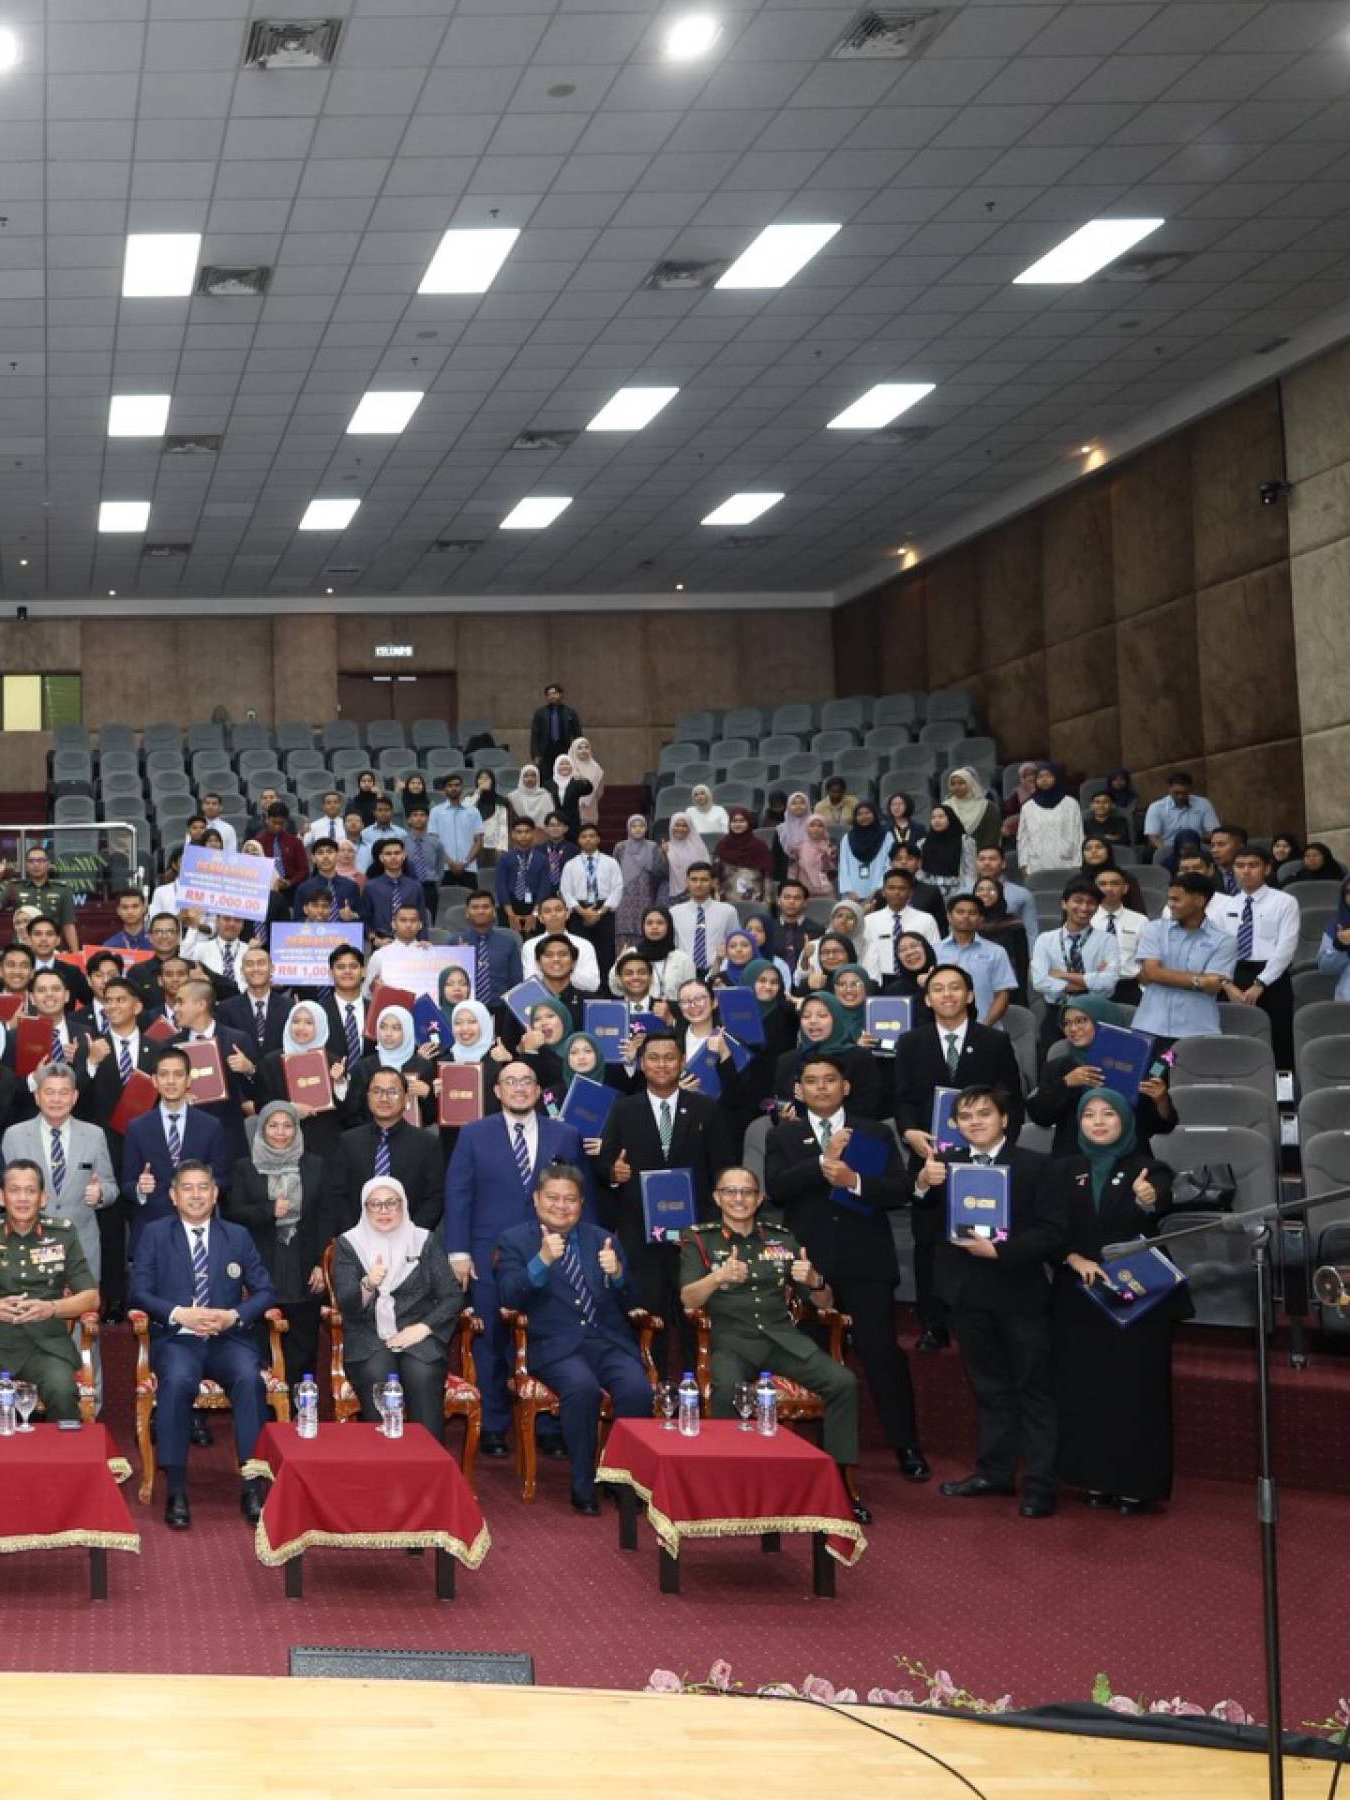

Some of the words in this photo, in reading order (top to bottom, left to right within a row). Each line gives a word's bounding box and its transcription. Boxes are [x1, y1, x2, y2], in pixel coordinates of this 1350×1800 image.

[185, 888, 204, 902] RM
[209, 893, 260, 911] 1,000.00
[277, 965, 298, 976] RM
